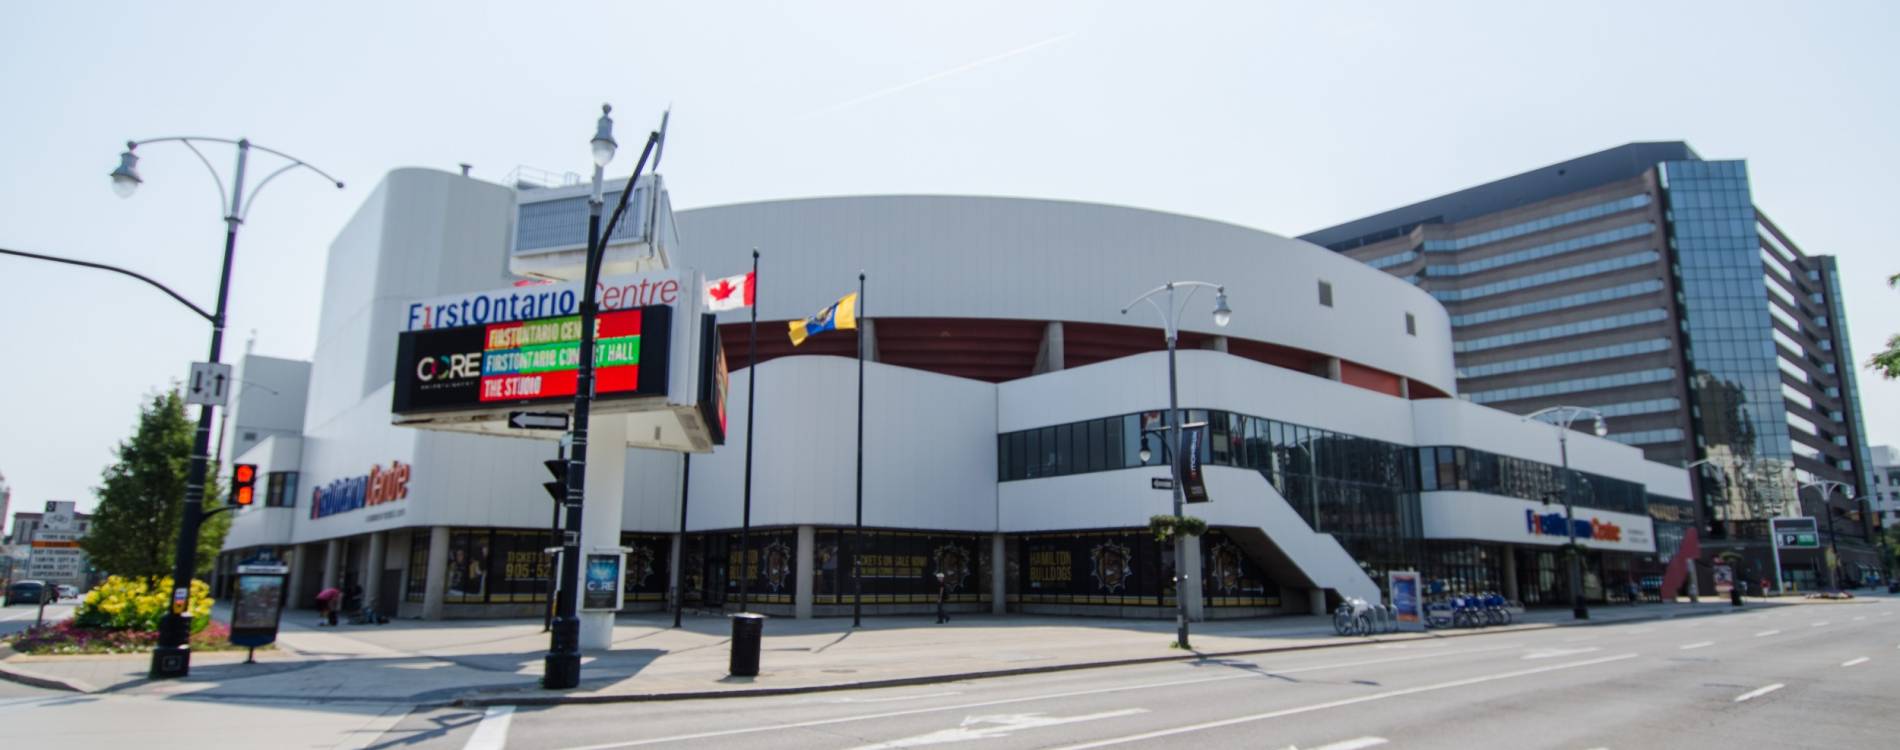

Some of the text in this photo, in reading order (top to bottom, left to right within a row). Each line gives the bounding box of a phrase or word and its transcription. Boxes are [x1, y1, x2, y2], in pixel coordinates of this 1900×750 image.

[560, 318, 601, 342] CENE
[485, 342, 633, 373] FIRSTONTARIO CONT HALL
[484, 376, 542, 398] THE STUDIO
